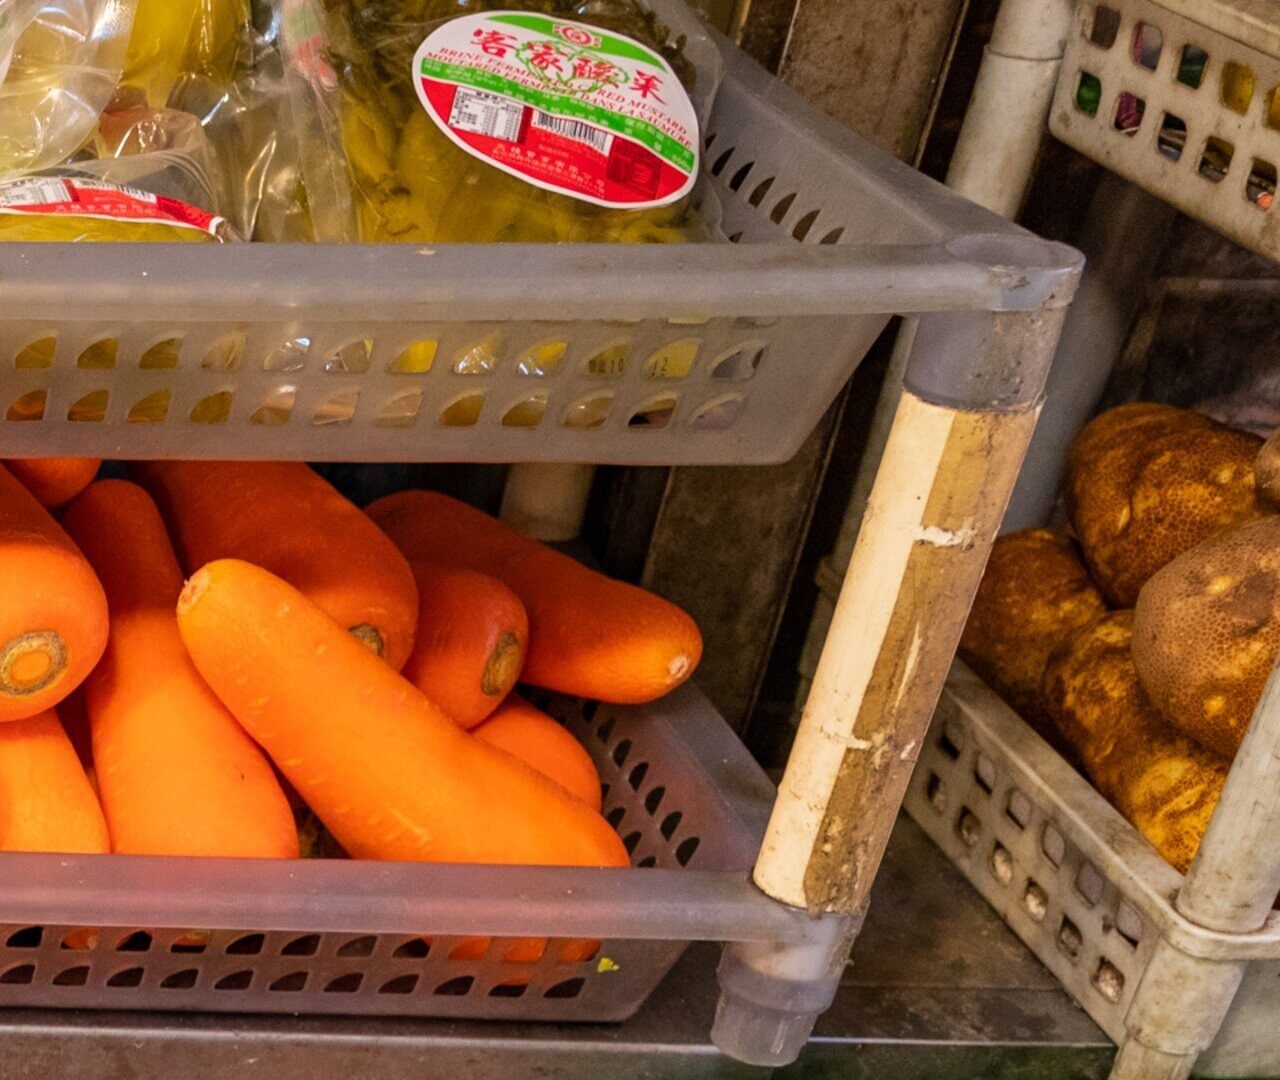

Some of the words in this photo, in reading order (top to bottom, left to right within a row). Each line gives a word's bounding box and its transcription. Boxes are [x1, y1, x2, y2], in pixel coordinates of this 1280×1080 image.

[425, 51, 501, 75] MOUTARED
[579, 91, 615, 110] DANS
[440, 47, 486, 63] BRINE
[628, 98, 688, 135] MUSTARD
[470, 28, 667, 105] 客家酸菜
